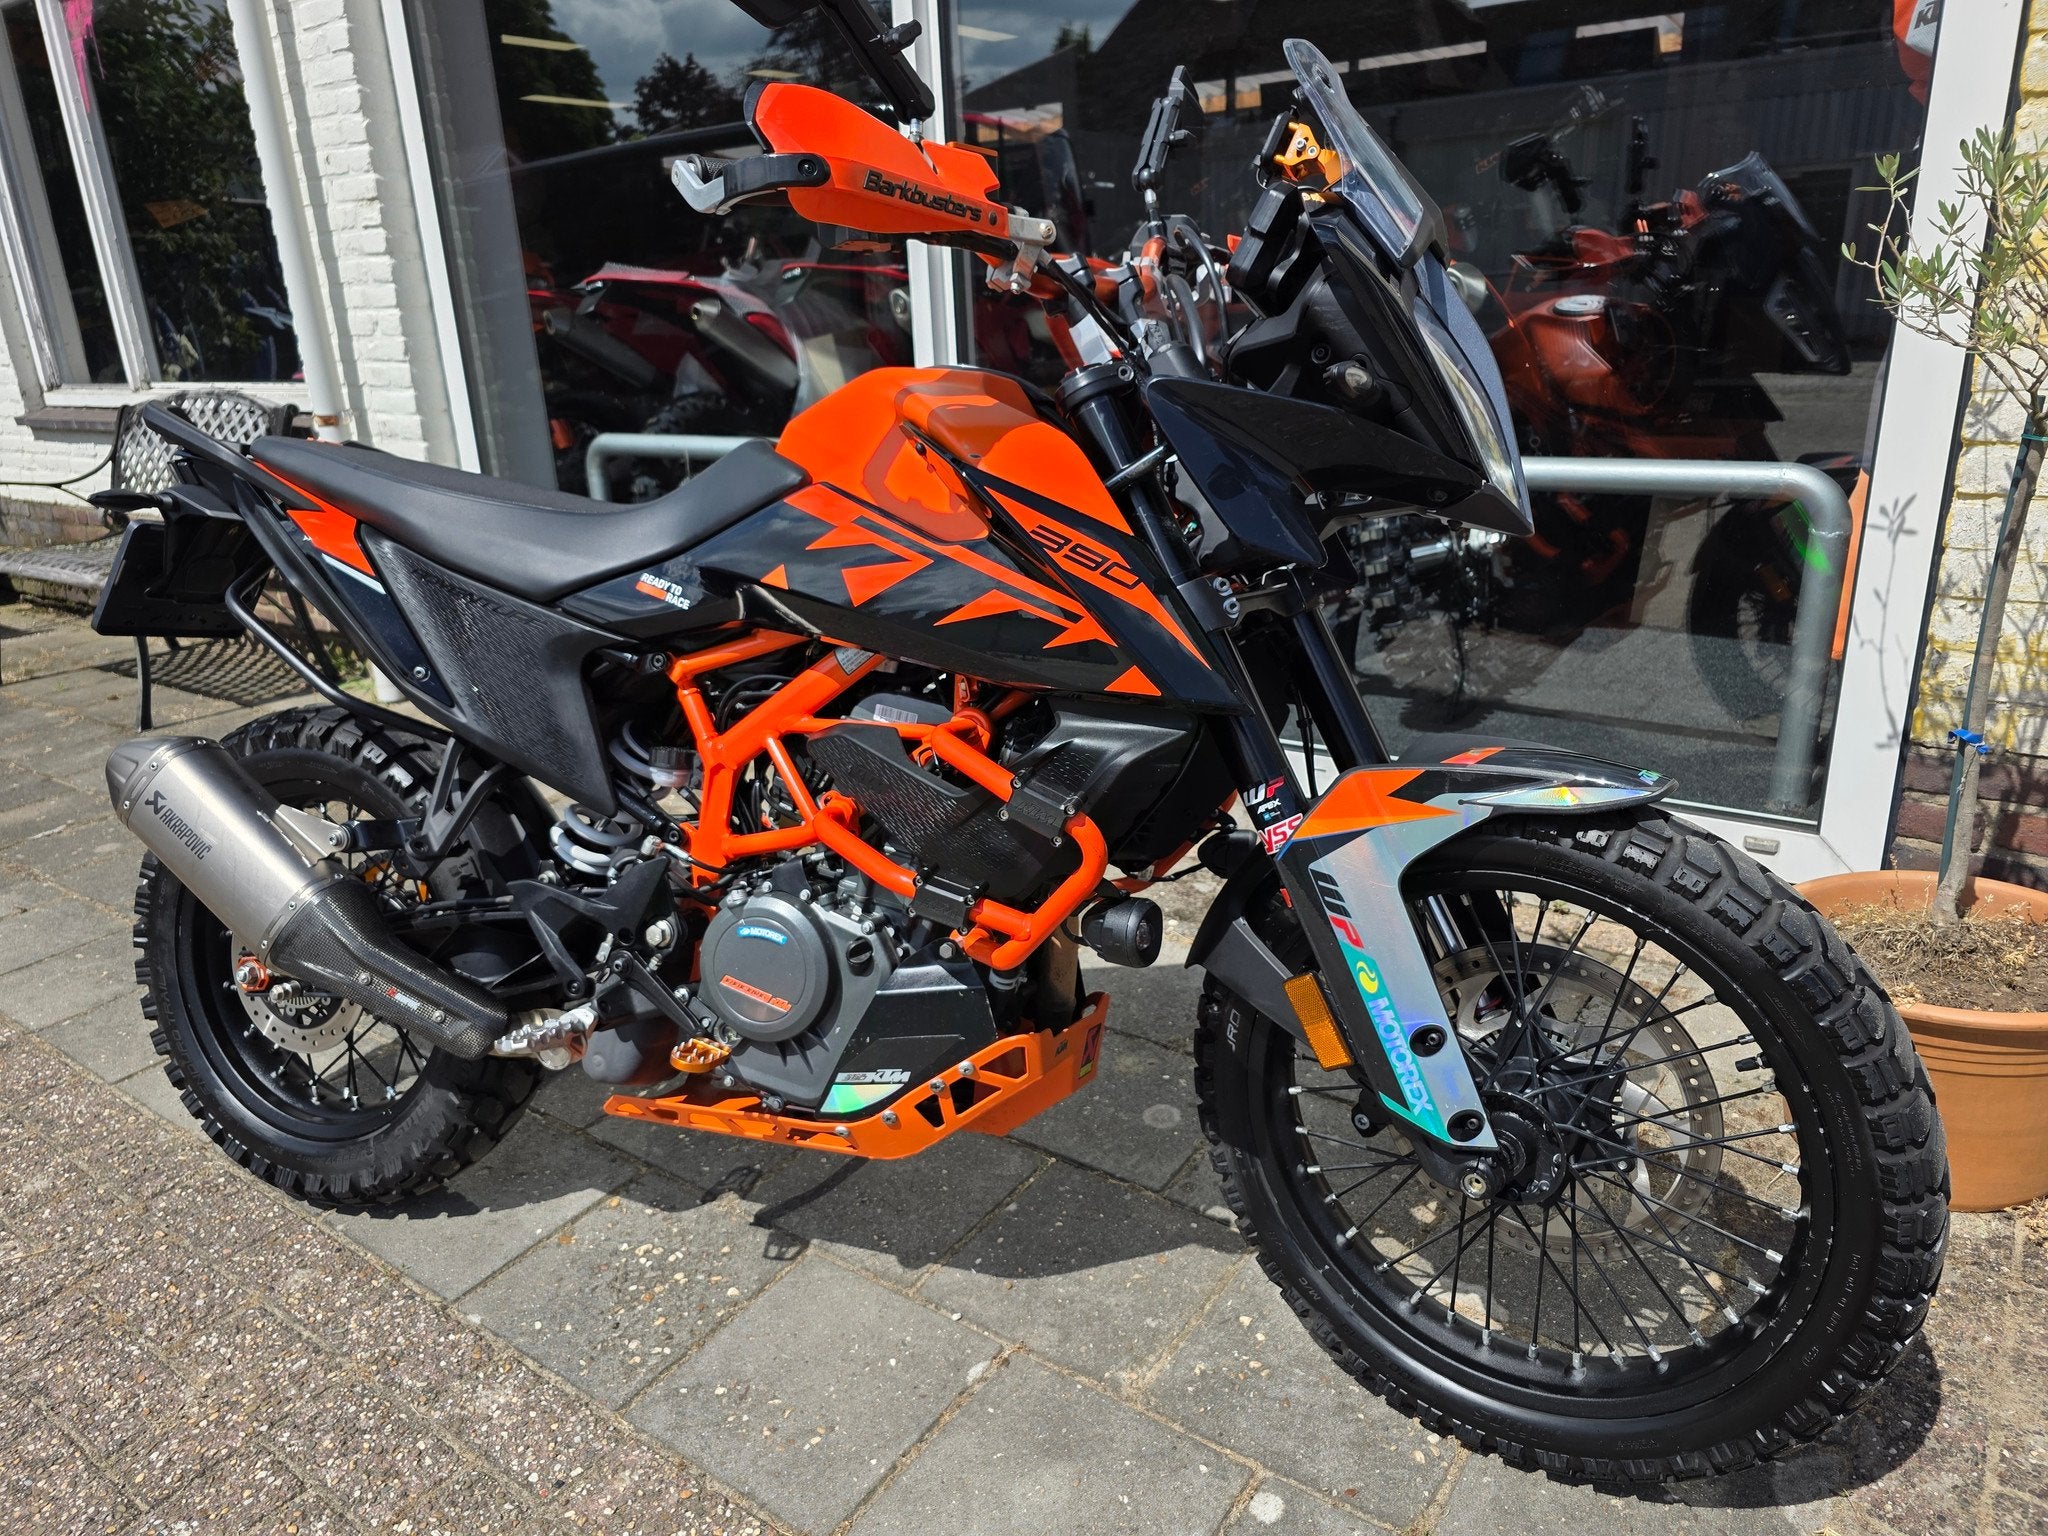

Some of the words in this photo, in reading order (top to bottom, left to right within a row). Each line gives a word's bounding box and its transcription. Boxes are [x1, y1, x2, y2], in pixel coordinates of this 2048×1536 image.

[1914, 0, 1940, 29] KT
[863, 169, 982, 222] Barkbusters
[1029, 524, 1142, 590] 390
[640, 572, 671, 591] READY
[671, 583, 683, 596] TO
[665, 592, 690, 610] RACE
[1257, 798, 1281, 814] APEX
[750, 927, 783, 943] MOTOREX
[1368, 998, 1434, 1117] MOTOREX
[866, 1068, 911, 1082] KTM
